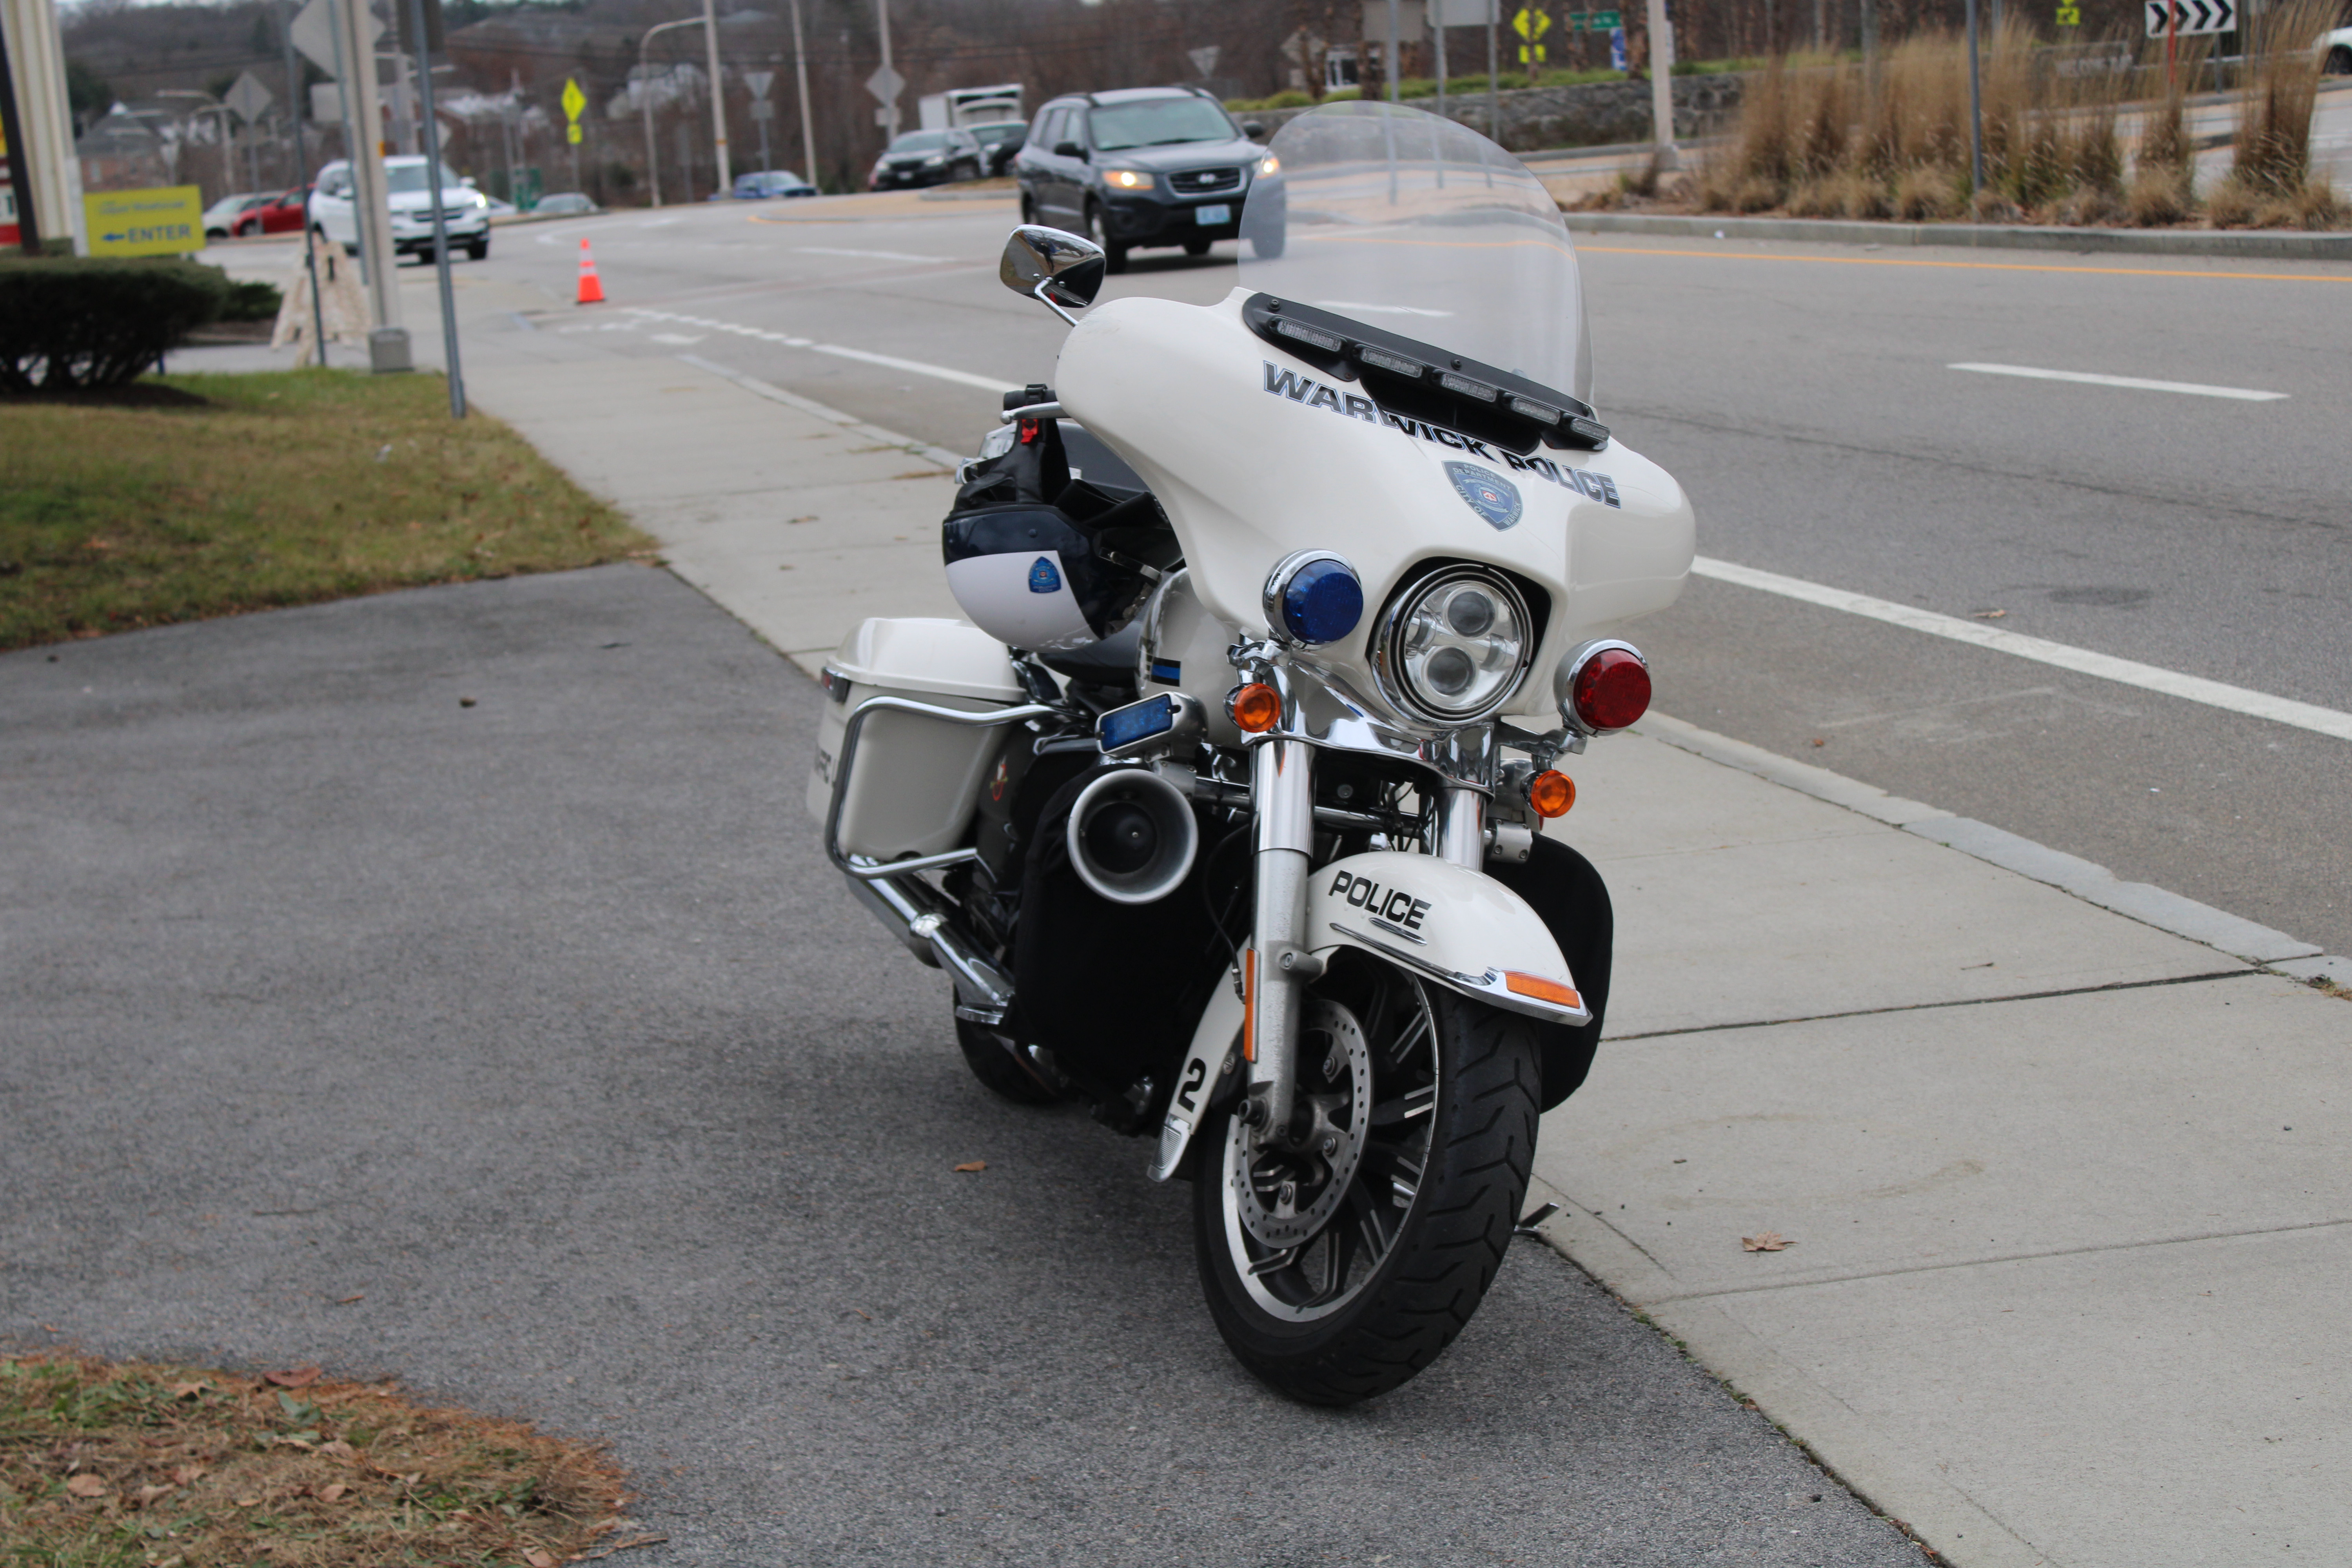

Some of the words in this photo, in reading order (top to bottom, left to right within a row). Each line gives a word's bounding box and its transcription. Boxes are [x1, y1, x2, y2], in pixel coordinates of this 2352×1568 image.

[129, 223, 191, 243] ENTER
[1263, 359, 1500, 464] WARWICK
[1496, 447, 1621, 509] POLICE
[1452, 467, 1511, 490] DEPARTMENT
[1463, 464, 1496, 479] POLICE
[1455, 485, 1474, 503] CITY
[1474, 506, 1488, 517] OF
[1503, 501, 1521, 526] WARWICK
[1328, 870, 1432, 930] POLICE
[1177, 1058, 1206, 1113] 2
